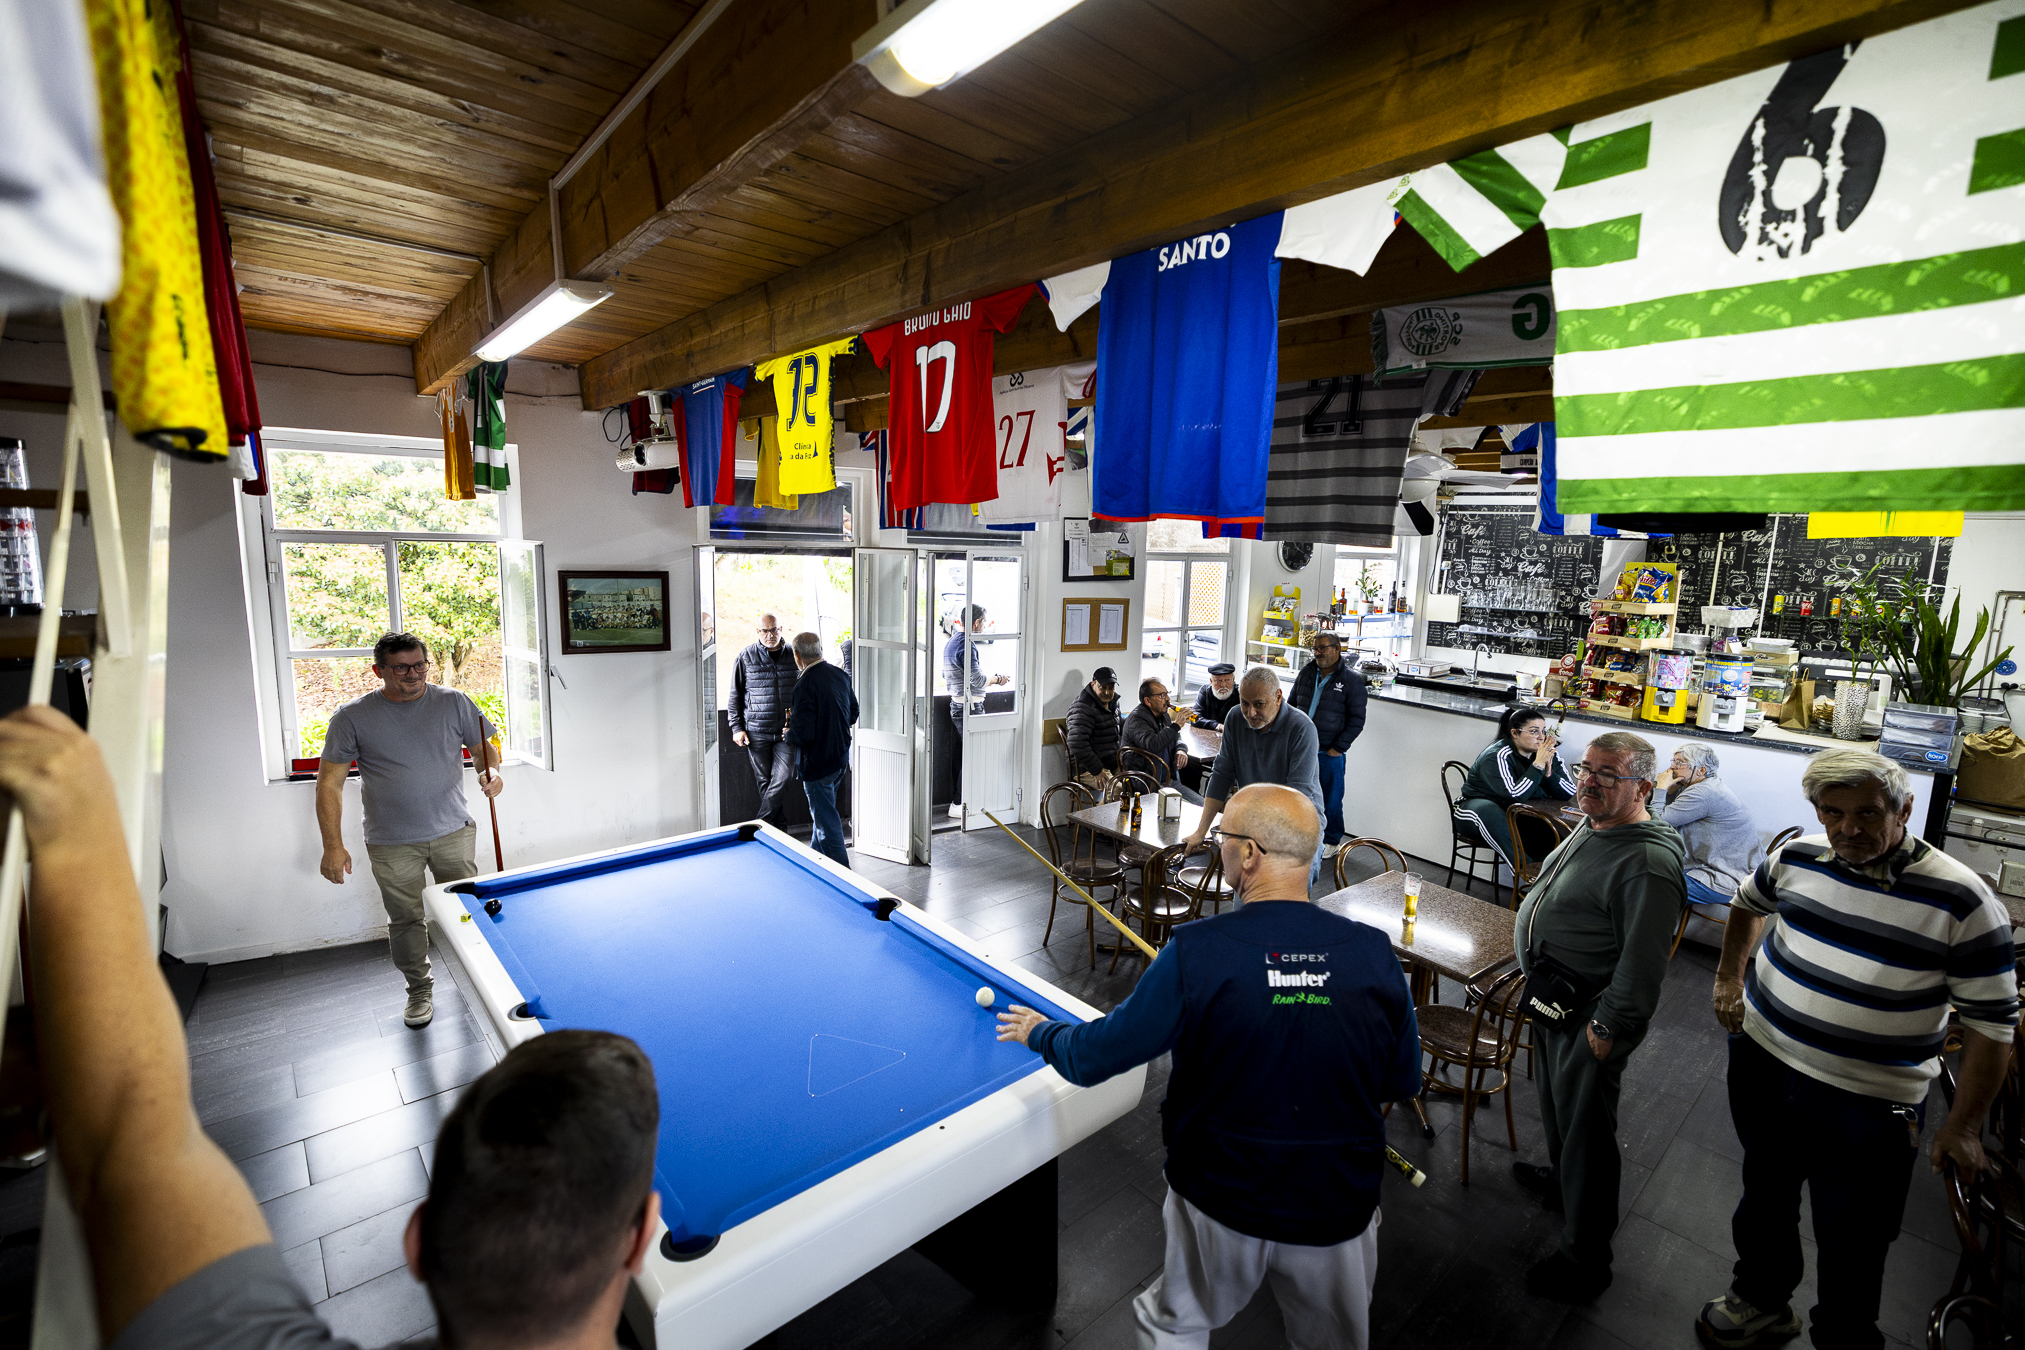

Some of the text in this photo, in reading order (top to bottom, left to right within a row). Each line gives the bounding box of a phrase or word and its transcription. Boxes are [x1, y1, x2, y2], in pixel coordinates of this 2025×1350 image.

[1719, 38, 1887, 260] 6
[1158, 232, 1230, 272] SANTO
[916, 340, 957, 433] 17
[1302, 374, 1364, 437] 21
[998, 410, 1036, 470] 27
[1461, 525, 1486, 538] Café
[1517, 561, 1546, 576] Café
[1281, 953, 1326, 962] CEPEX
[1267, 969, 1330, 988] Hunter
[1530, 996, 1561, 1020] PUMA
